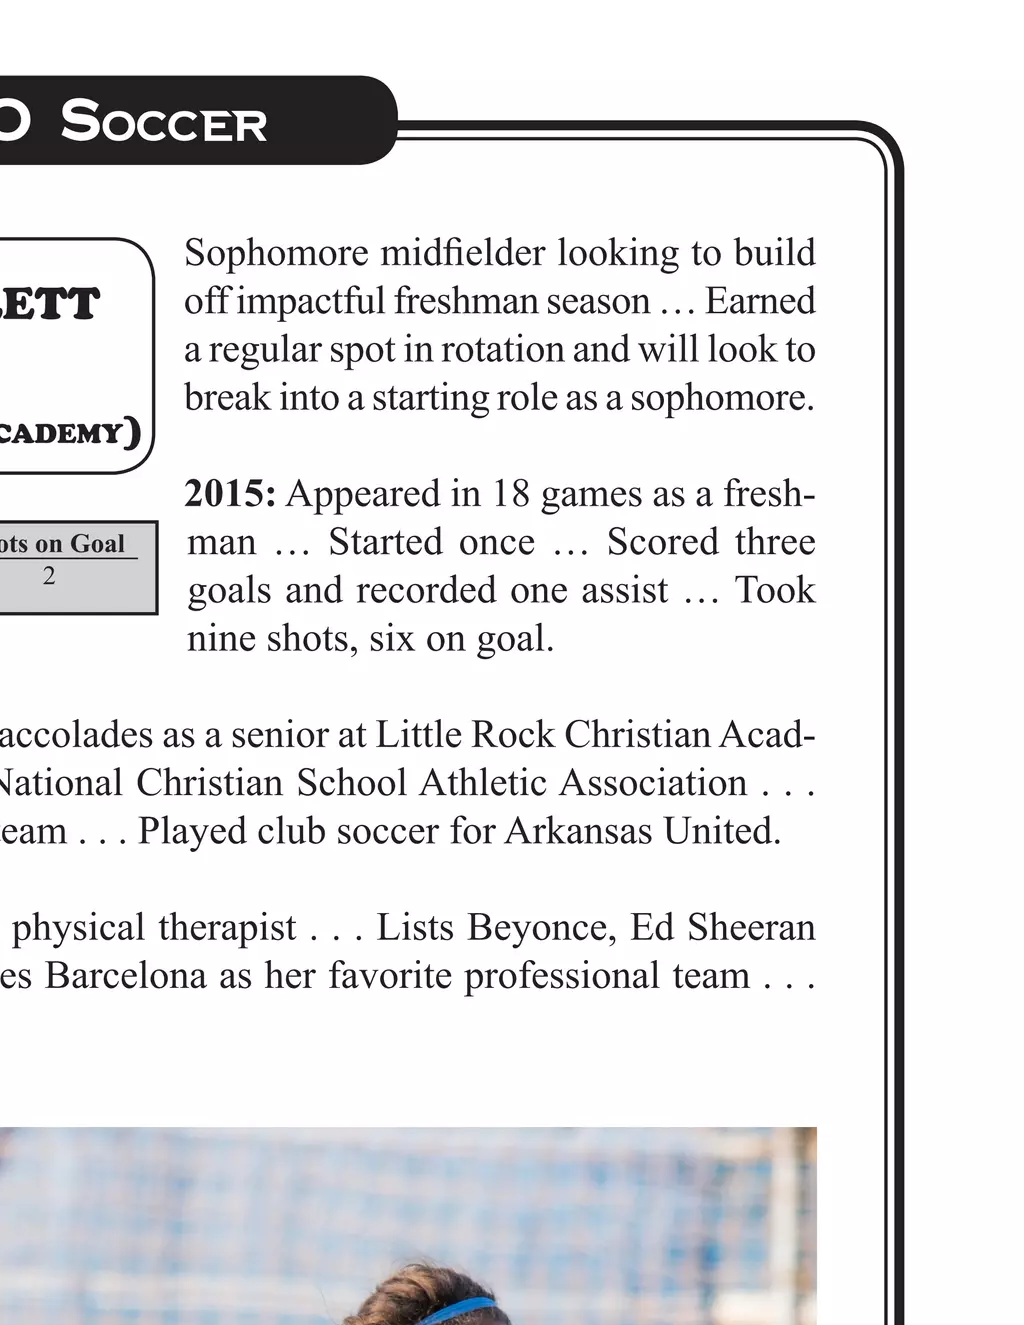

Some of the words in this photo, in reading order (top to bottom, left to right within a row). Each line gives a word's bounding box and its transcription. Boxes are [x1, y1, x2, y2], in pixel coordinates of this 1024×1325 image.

[185, 236, 369, 275] Sophomore
[380, 236, 547, 267] midfielder
[557, 236, 680, 275] looking
[691, 241, 722, 267] to
[733, 236, 817, 267] build
[184, 284, 234, 315] off
[236, 284, 386, 323] impactful
[394, 284, 540, 315] freshman
[547, 294, 651, 315] season
[705, 284, 817, 315] Earned
[184, 342, 203, 363] a
[208, 333, 323, 371] regular
[330, 337, 397, 371] spot
[403, 333, 434, 363] in
[441, 333, 566, 363] rotation
[573, 333, 631, 363] and
[637, 333, 699, 363] will
[708, 333, 779, 363] look
[785, 337, 816, 363] to
[184, 381, 272, 411] break
[279, 381, 340, 411] into
[347, 390, 365, 411] a
[373, 381, 490, 419] starting
[496, 381, 558, 411] role
[566, 390, 598, 411] as
[606, 390, 624, 411] a
[631, 381, 814, 419] sophomore.
[184, 478, 275, 508] 2015:
[284, 477, 442, 516] Appeared
[451, 477, 482, 507] in
[495, 478, 530, 508] 18
[541, 486, 643, 516] games
[653, 486, 685, 508] as
[696, 486, 714, 507] a
[723, 477, 816, 508] fresh-
[35, 538, 63, 553] on
[70, 533, 125, 554] Goal
[187, 535, 257, 556] man
[329, 525, 444, 556] Started
[459, 535, 535, 556] once
[608, 525, 720, 556] Scored
[734, 525, 816, 556] three
[43, 565, 56, 585] 2
[187, 573, 272, 612] goals
[286, 573, 344, 604] and
[356, 573, 498, 604] recorded
[510, 583, 568, 604] one
[582, 573, 669, 604] assist
[734, 574, 817, 604] Took
[187, 622, 256, 652] nine
[267, 622, 358, 658] shots,
[370, 622, 416, 652] six
[426, 631, 467, 652] on
[476, 622, 553, 660] goal.
[163, 727, 195, 749] as
[205, 727, 223, 748] a
[232, 718, 330, 749] senior
[338, 722, 367, 748] at
[375, 718, 462, 748] Little
[471, 718, 557, 749] Rock
[565, 718, 712, 749] Christian
[718, 718, 816, 749] Acad-
[137, 766, 284, 797] Christian
[298, 766, 408, 797] School
[418, 766, 547, 797] Athletic
[558, 766, 748, 797] Association
[138, 814, 248, 853] Played
[258, 814, 326, 845] club
[337, 824, 440, 845] soccer
[450, 814, 497, 845] for
[503, 814, 653, 845] Arkansas
[663, 814, 780, 845] United.
[11, 911, 146, 949] physical
[158, 911, 297, 949] therapist
[376, 911, 454, 941] Lists
[467, 912, 616, 949] Beyonce,
[630, 911, 675, 941] Ed
[688, 911, 817, 941] Sheeran
[44, 959, 208, 989] Barcelona
[219, 968, 252, 990] as
[264, 959, 317, 989] her
[328, 959, 452, 990] favorite
[464, 959, 660, 998] professional
[672, 963, 751, 989] team
